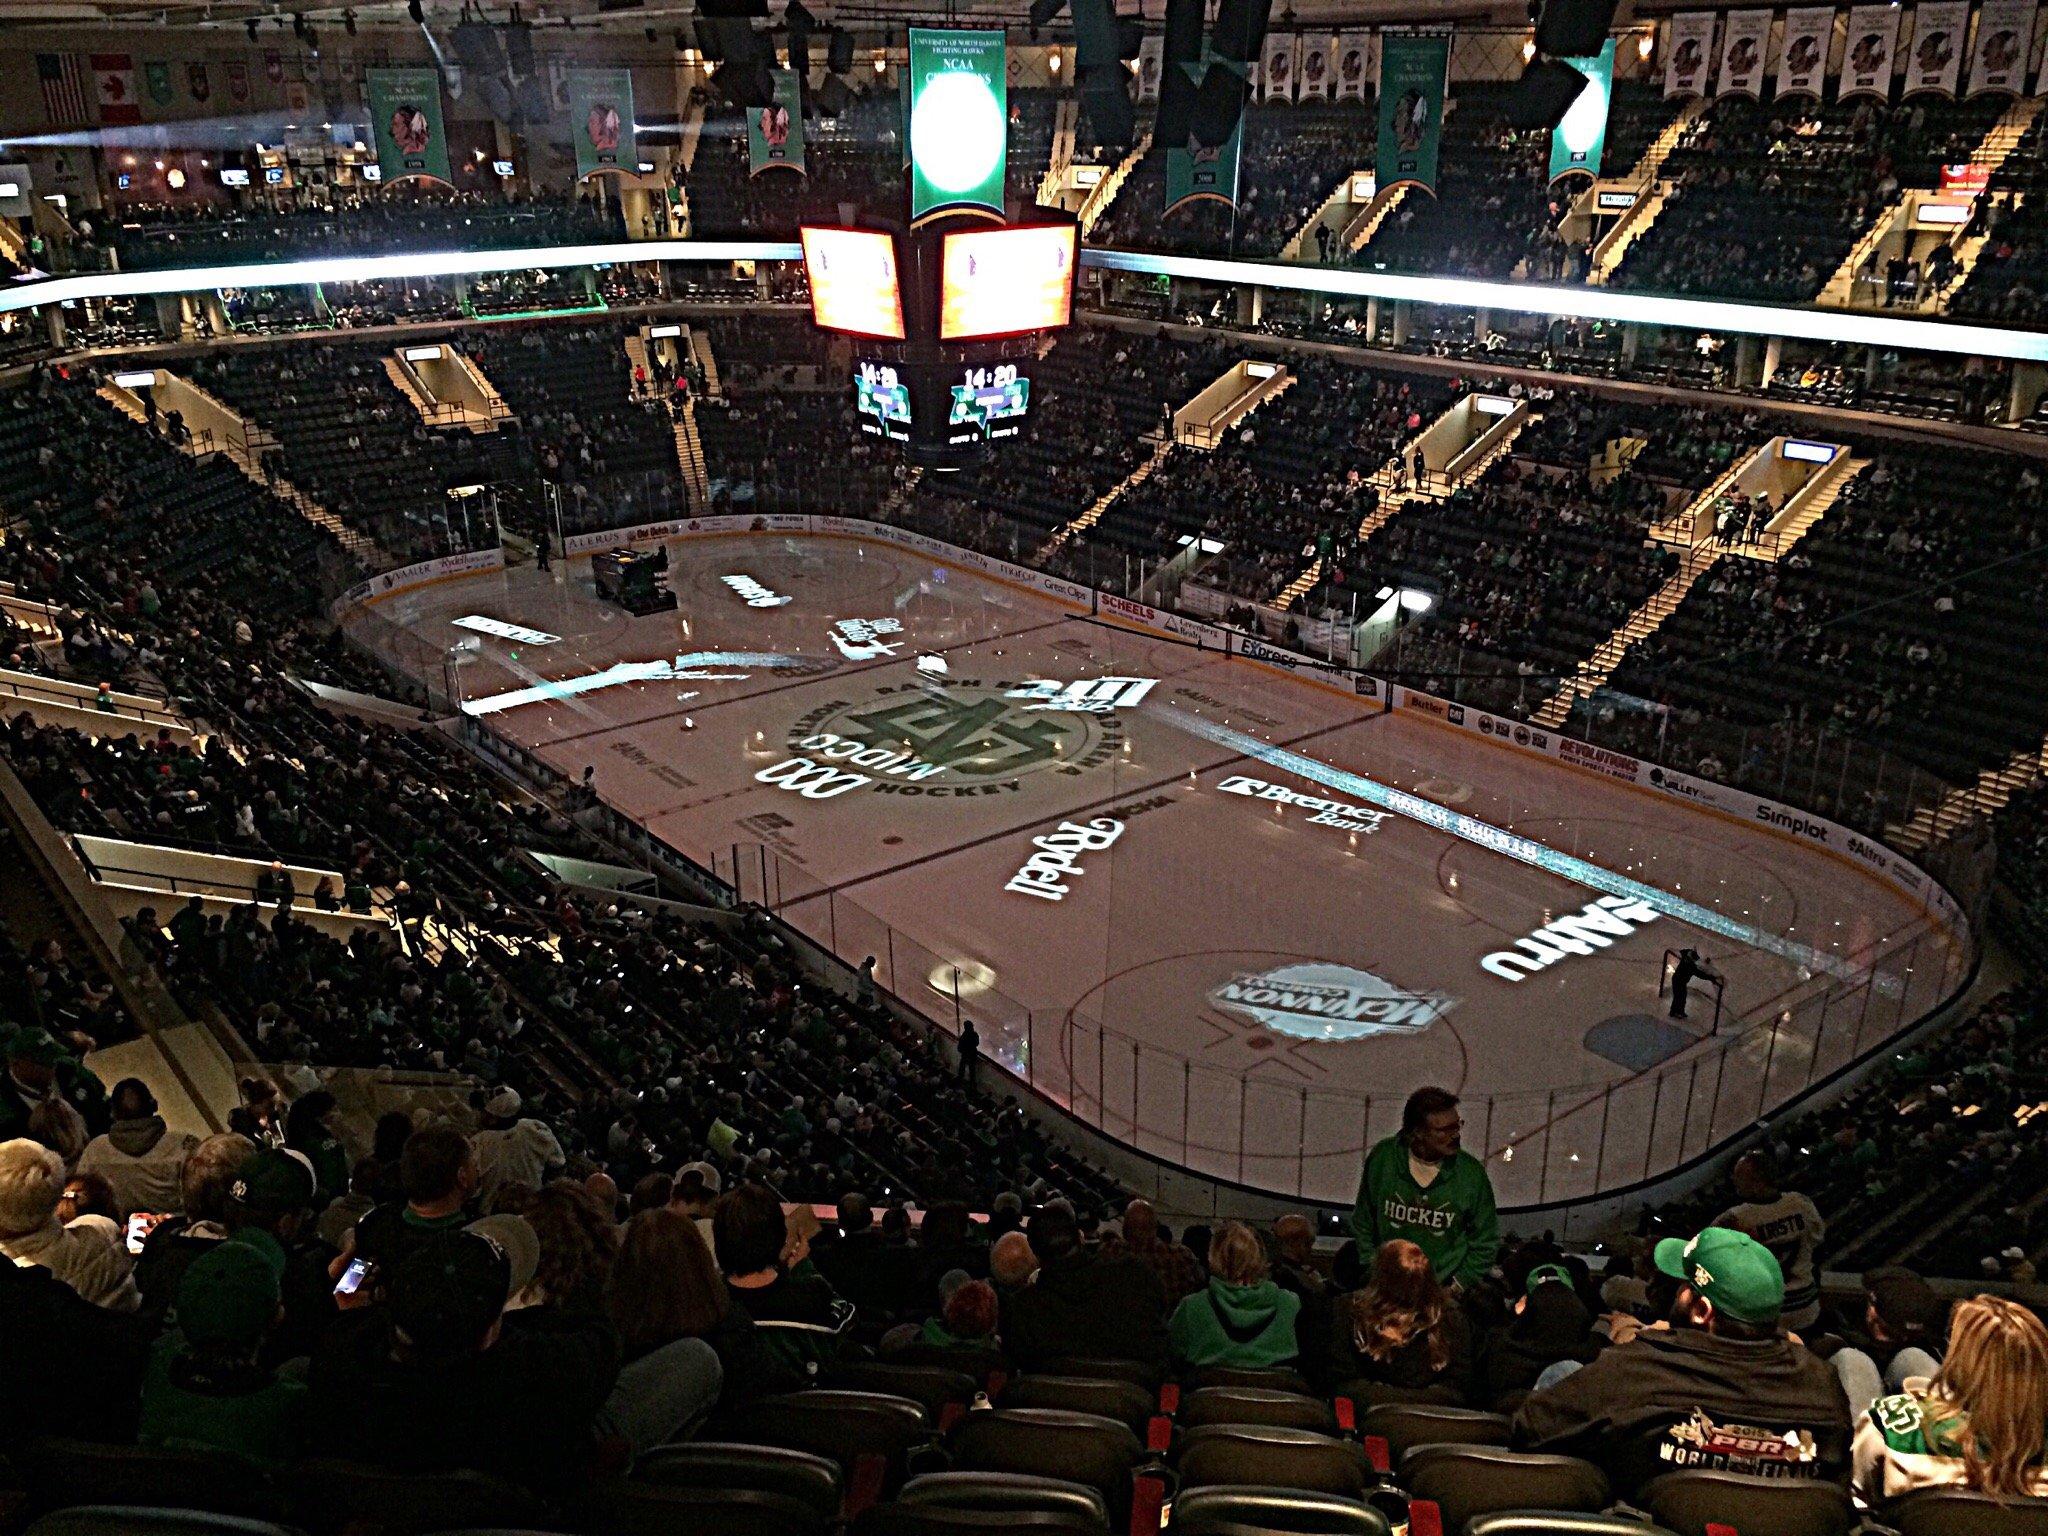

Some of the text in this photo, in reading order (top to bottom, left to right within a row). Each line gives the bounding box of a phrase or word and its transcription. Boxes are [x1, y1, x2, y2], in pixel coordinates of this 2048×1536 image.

[914, 38, 948, 46] UNIVERSITY
[943, 58, 974, 70] NCAA
[964, 364, 1017, 390] 14:20
[569, 533, 620, 549] ALERUS
[1043, 578, 1087, 602] Great Clips
[1101, 593, 1156, 621] SCHEELS
[1240, 638, 1298, 669] Express
[1411, 697, 1463, 721] Butler CAT
[800, 733, 947, 781] MIDCO
[1559, 738, 1640, 774] REVOLUTIONS
[873, 781, 1021, 798] HOCKEY
[1663, 779, 1700, 797] VALLEY
[1255, 784, 1395, 823] Bremer
[1305, 811, 1380, 835] Bank
[1755, 804, 1828, 843] Simplot
[1003, 817, 1126, 901] Rydell
[1854, 841, 1887, 868] Altru
[1384, 1199, 1456, 1229] HOCKEY
[1659, 1441, 1724, 1473] WORLD
[1711, 1434, 1782, 1454] PBR
